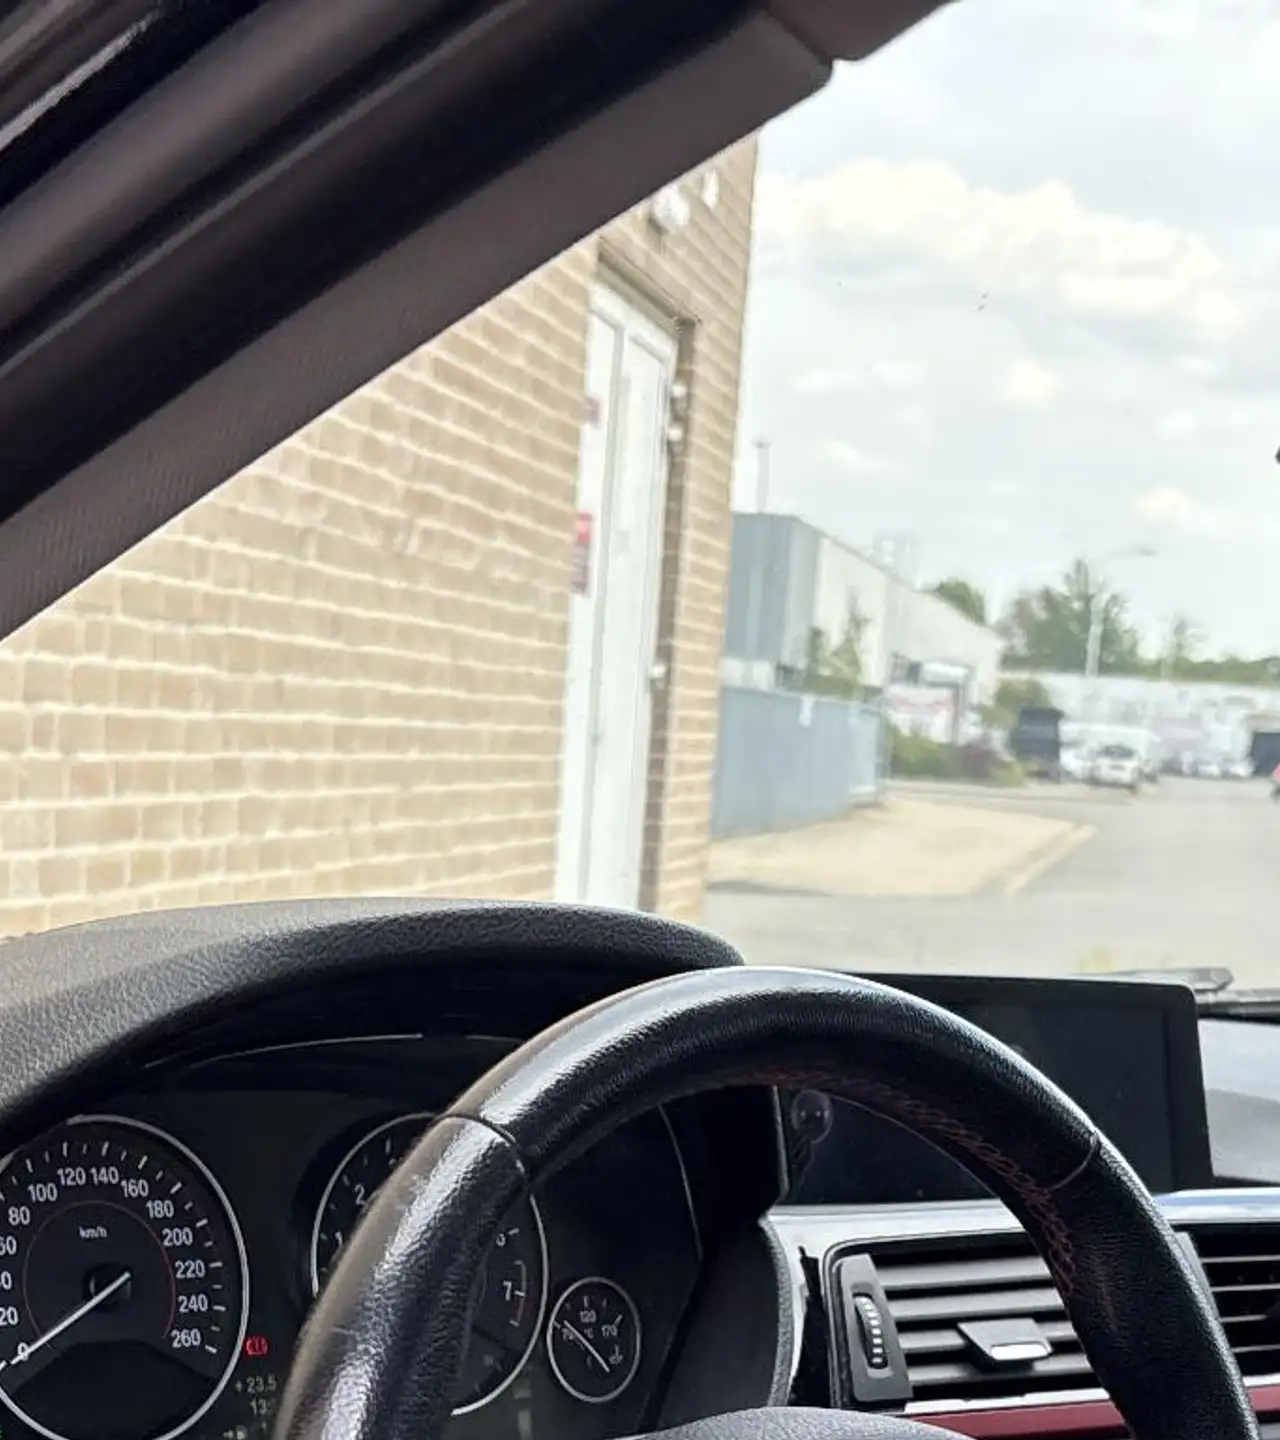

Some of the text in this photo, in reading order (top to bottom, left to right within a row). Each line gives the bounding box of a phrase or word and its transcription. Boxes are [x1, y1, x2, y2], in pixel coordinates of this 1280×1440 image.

[57, 1167, 86, 1186] 120
[90, 1166, 119, 1185] 140
[27, 1183, 58, 1202] 100
[121, 1179, 149, 1198] 160
[354, 1183, 366, 1206] 2
[8, 1206, 31, 1226] 80
[146, 1200, 174, 1219] 180
[79, 1226, 108, 1240] km/h
[162, 1227, 194, 1247] 200
[175, 1259, 206, 1279] 220
[503, 1281, 513, 1302] 7
[178, 1293, 209, 1313] 240
[171, 1328, 201, 1348] 260
